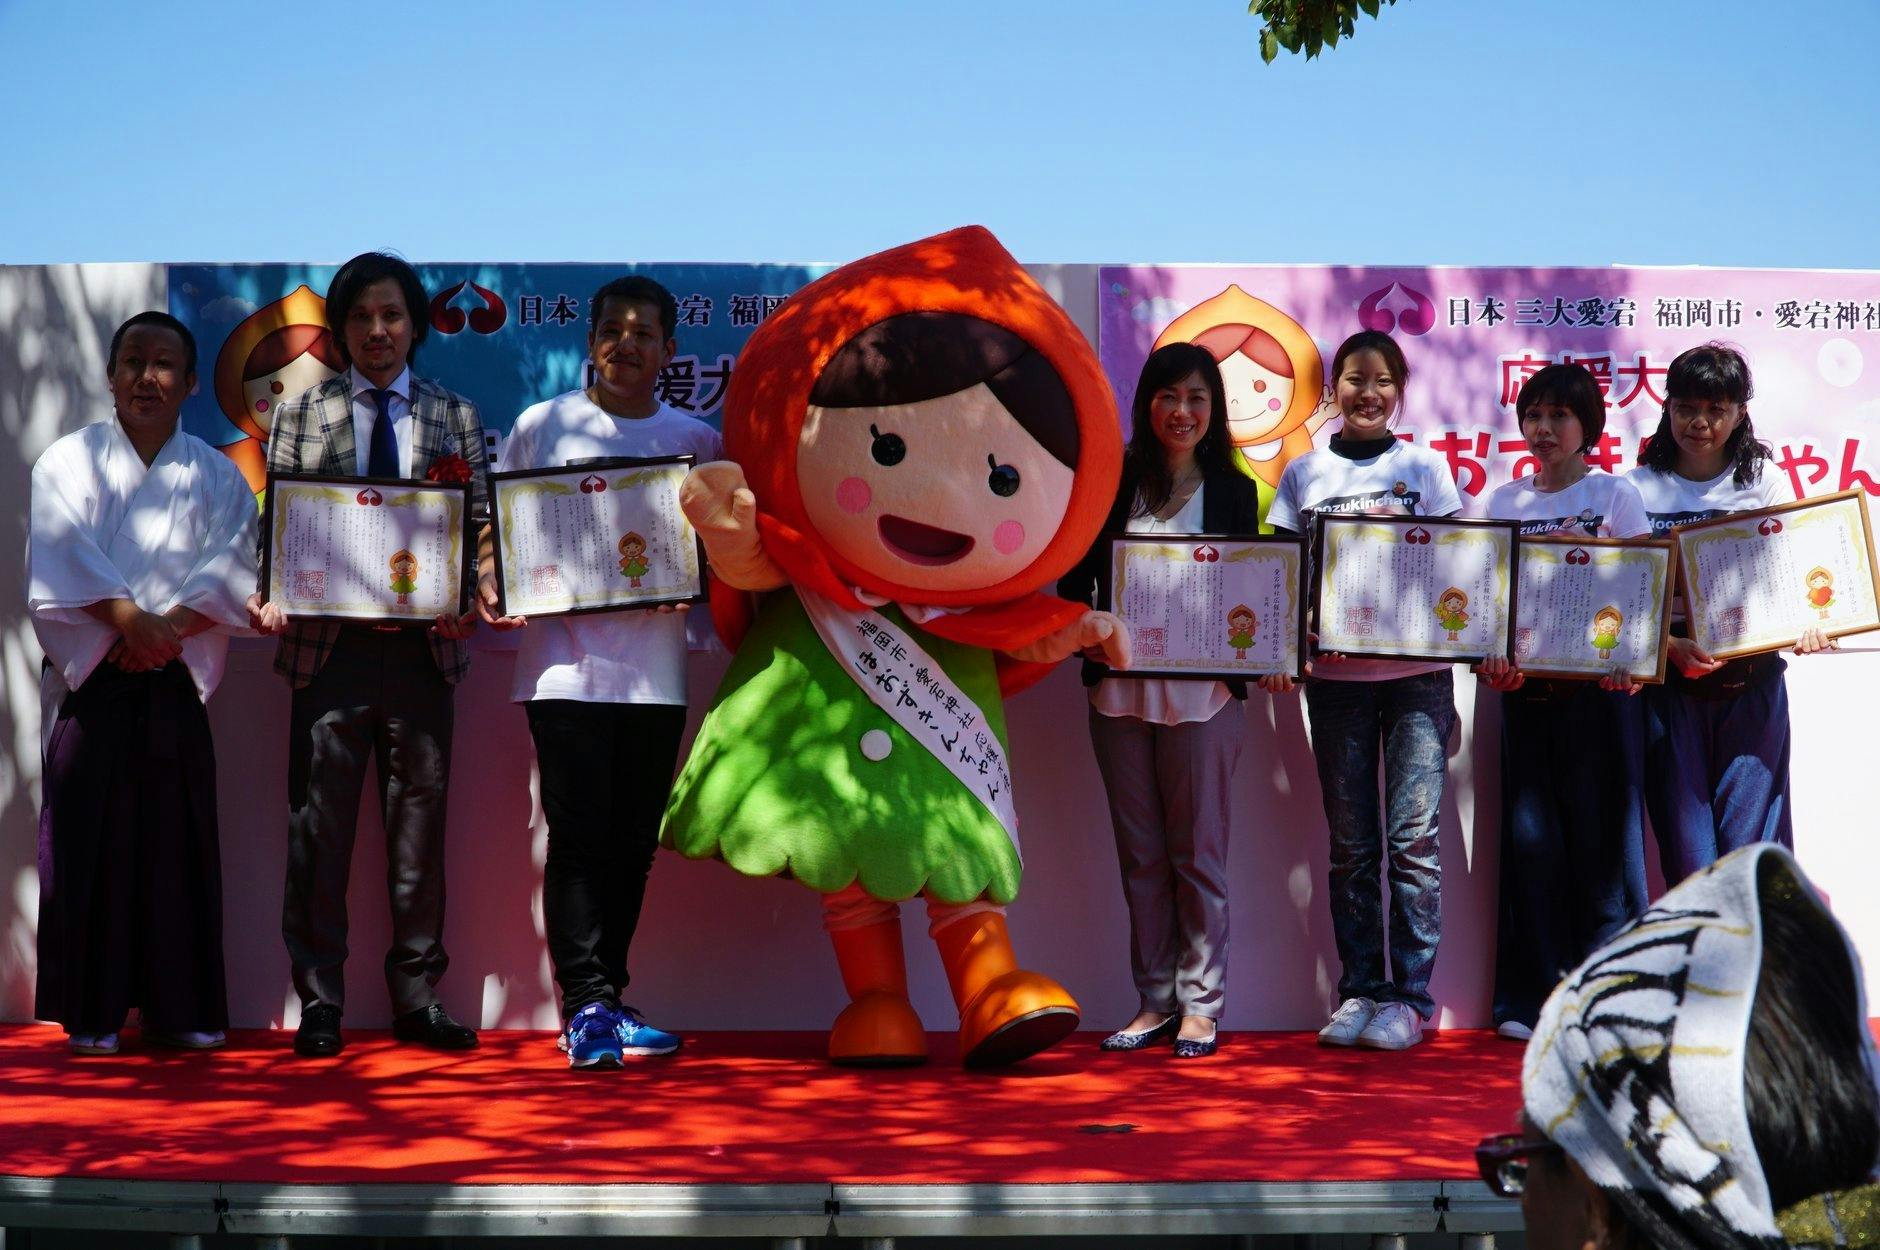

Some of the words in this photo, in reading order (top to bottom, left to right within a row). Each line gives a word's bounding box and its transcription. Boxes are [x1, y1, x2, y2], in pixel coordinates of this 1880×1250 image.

[855, 651, 999, 801] ほおずきんちゃん
